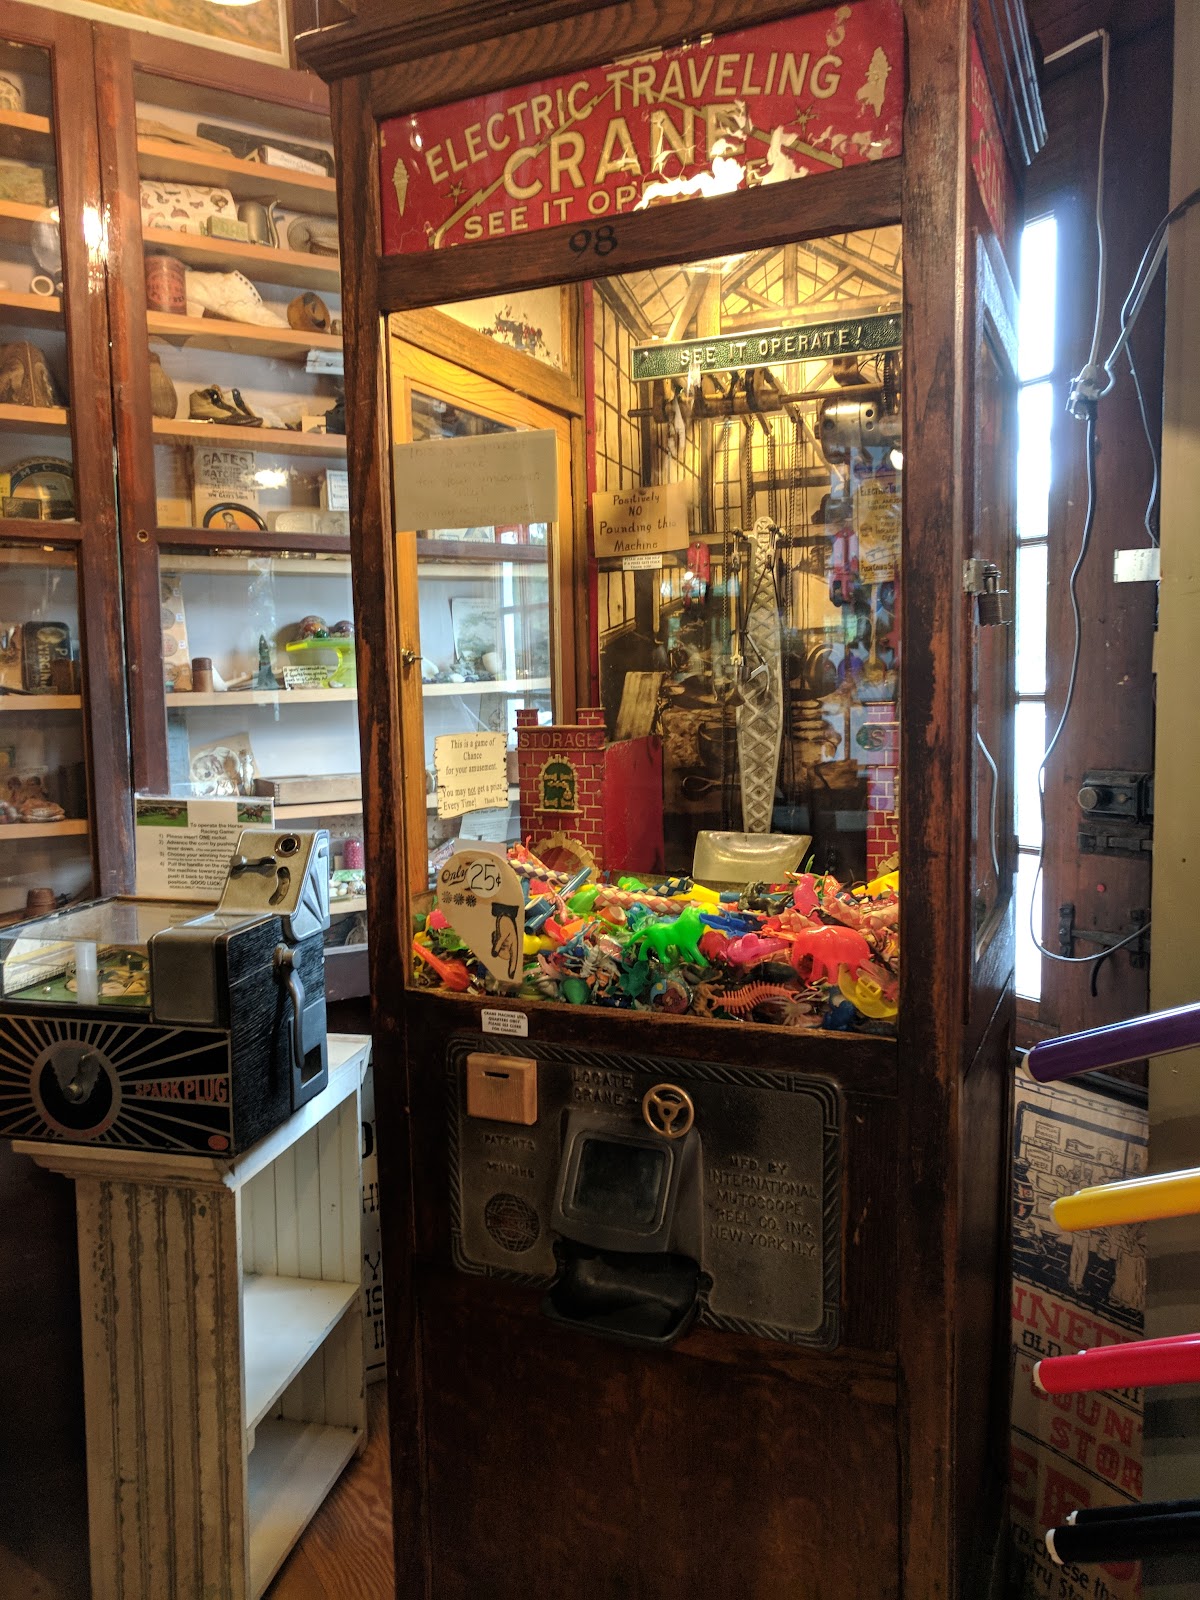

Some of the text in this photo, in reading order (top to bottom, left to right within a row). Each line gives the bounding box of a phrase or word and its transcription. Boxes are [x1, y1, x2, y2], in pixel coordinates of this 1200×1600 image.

[425, 51, 844, 185] ELECTRIC TRAVELING
[502, 101, 747, 201] CRANE
[464, 210, 528, 240] SEE
[543, 196, 574, 226] IT
[568, 223, 619, 258] 98
[680, 327, 863, 366] SEE IT OPERATE!
[203, 452, 249, 470] GATES
[613, 491, 660, 506] Positively
[629, 506, 642, 516] NO
[600, 521, 652, 535] Pounding
[613, 539, 658, 552] Machine
[451, 739, 462, 749] This
[464, 739, 469, 748] is
[474, 740, 488, 749] game
[488, 737, 496, 746] of
[520, 732, 597, 748] STORAGE
[463, 751, 482, 761] Chance
[445, 765, 454, 775] for
[455, 766, 467, 776] your
[442, 788, 454, 798] You
[455, 788, 466, 797] may
[467, 786, 476, 796] not
[477, 784, 485, 795] get
[443, 801, 460, 812] Every
[441, 865, 469, 886] Only
[572, 1067, 634, 1090] LOCATE
[573, 1086, 625, 1107] CRANE
[767, 1161, 788, 1175] BY
[707, 1168, 819, 1200] INTERNATIONAL
[716, 1188, 803, 1216] MUTOSCOPE
[715, 1208, 751, 1227] REEL
[758, 1215, 780, 1231] CO.
[709, 1224, 744, 1243] NEW
